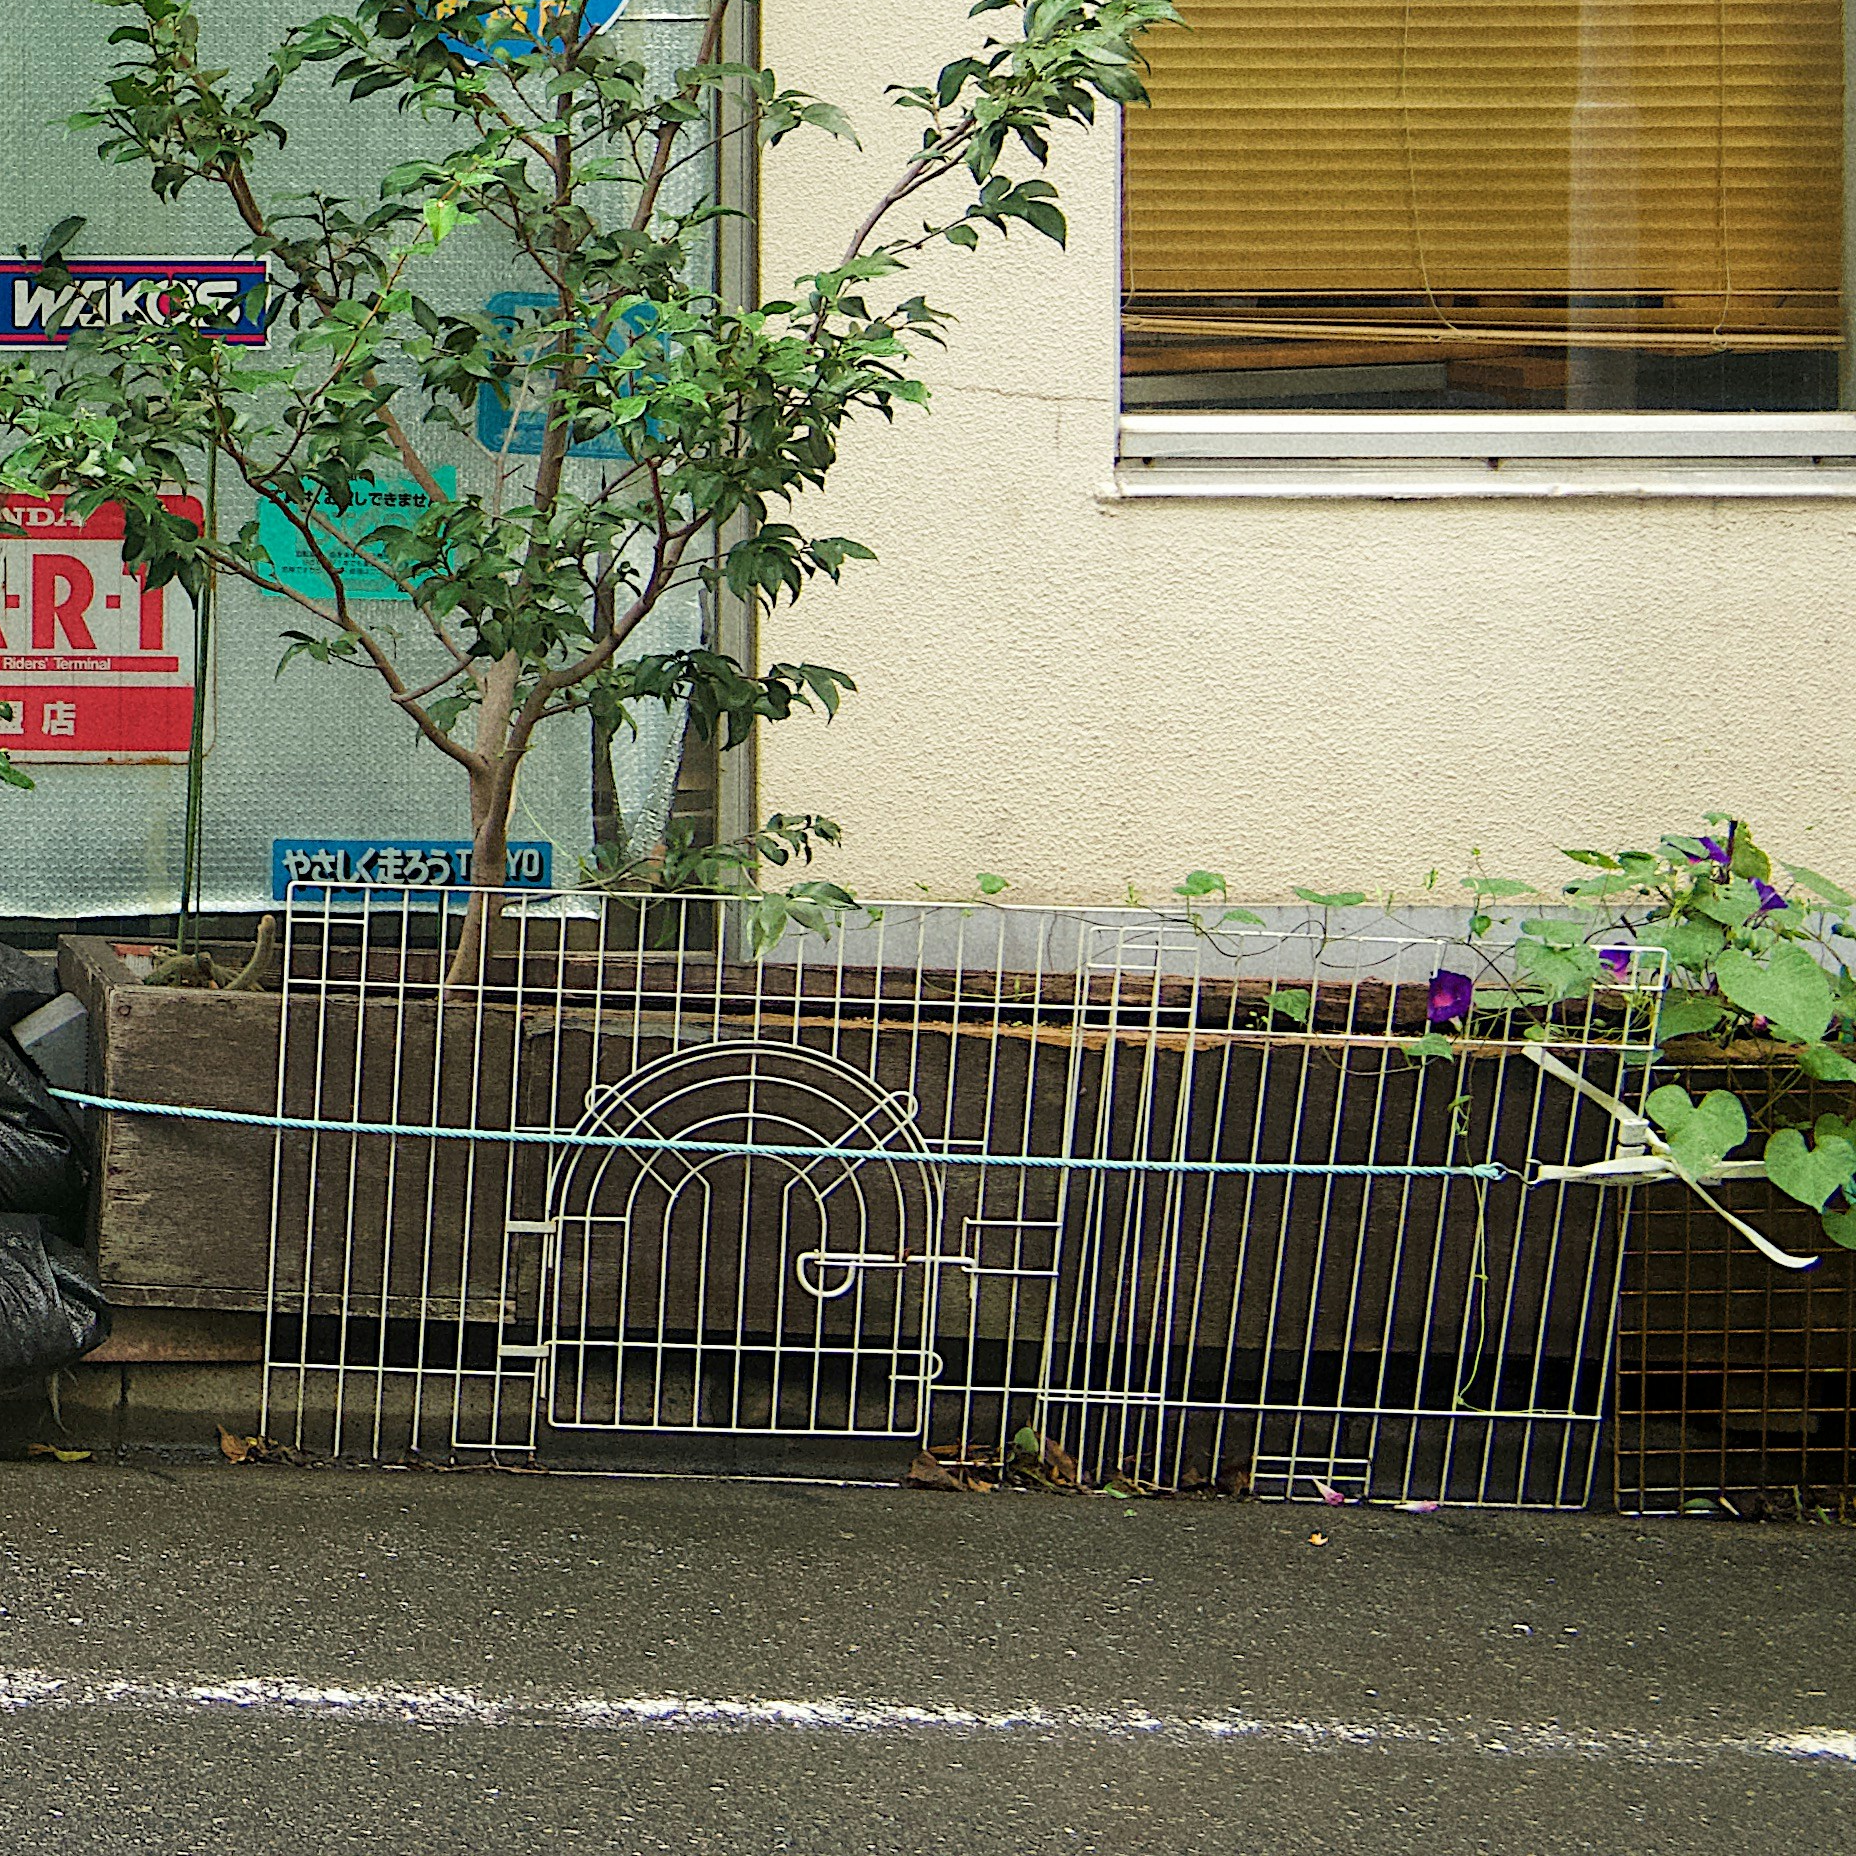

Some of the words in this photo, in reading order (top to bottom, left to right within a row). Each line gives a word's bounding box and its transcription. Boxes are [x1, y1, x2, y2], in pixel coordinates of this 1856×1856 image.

[2, 656, 49, 670] Riders'
[54, 656, 112, 671] Terminal
[282, 846, 454, 886] やさしく走ろう
[455, 848, 544, 879] TYO
